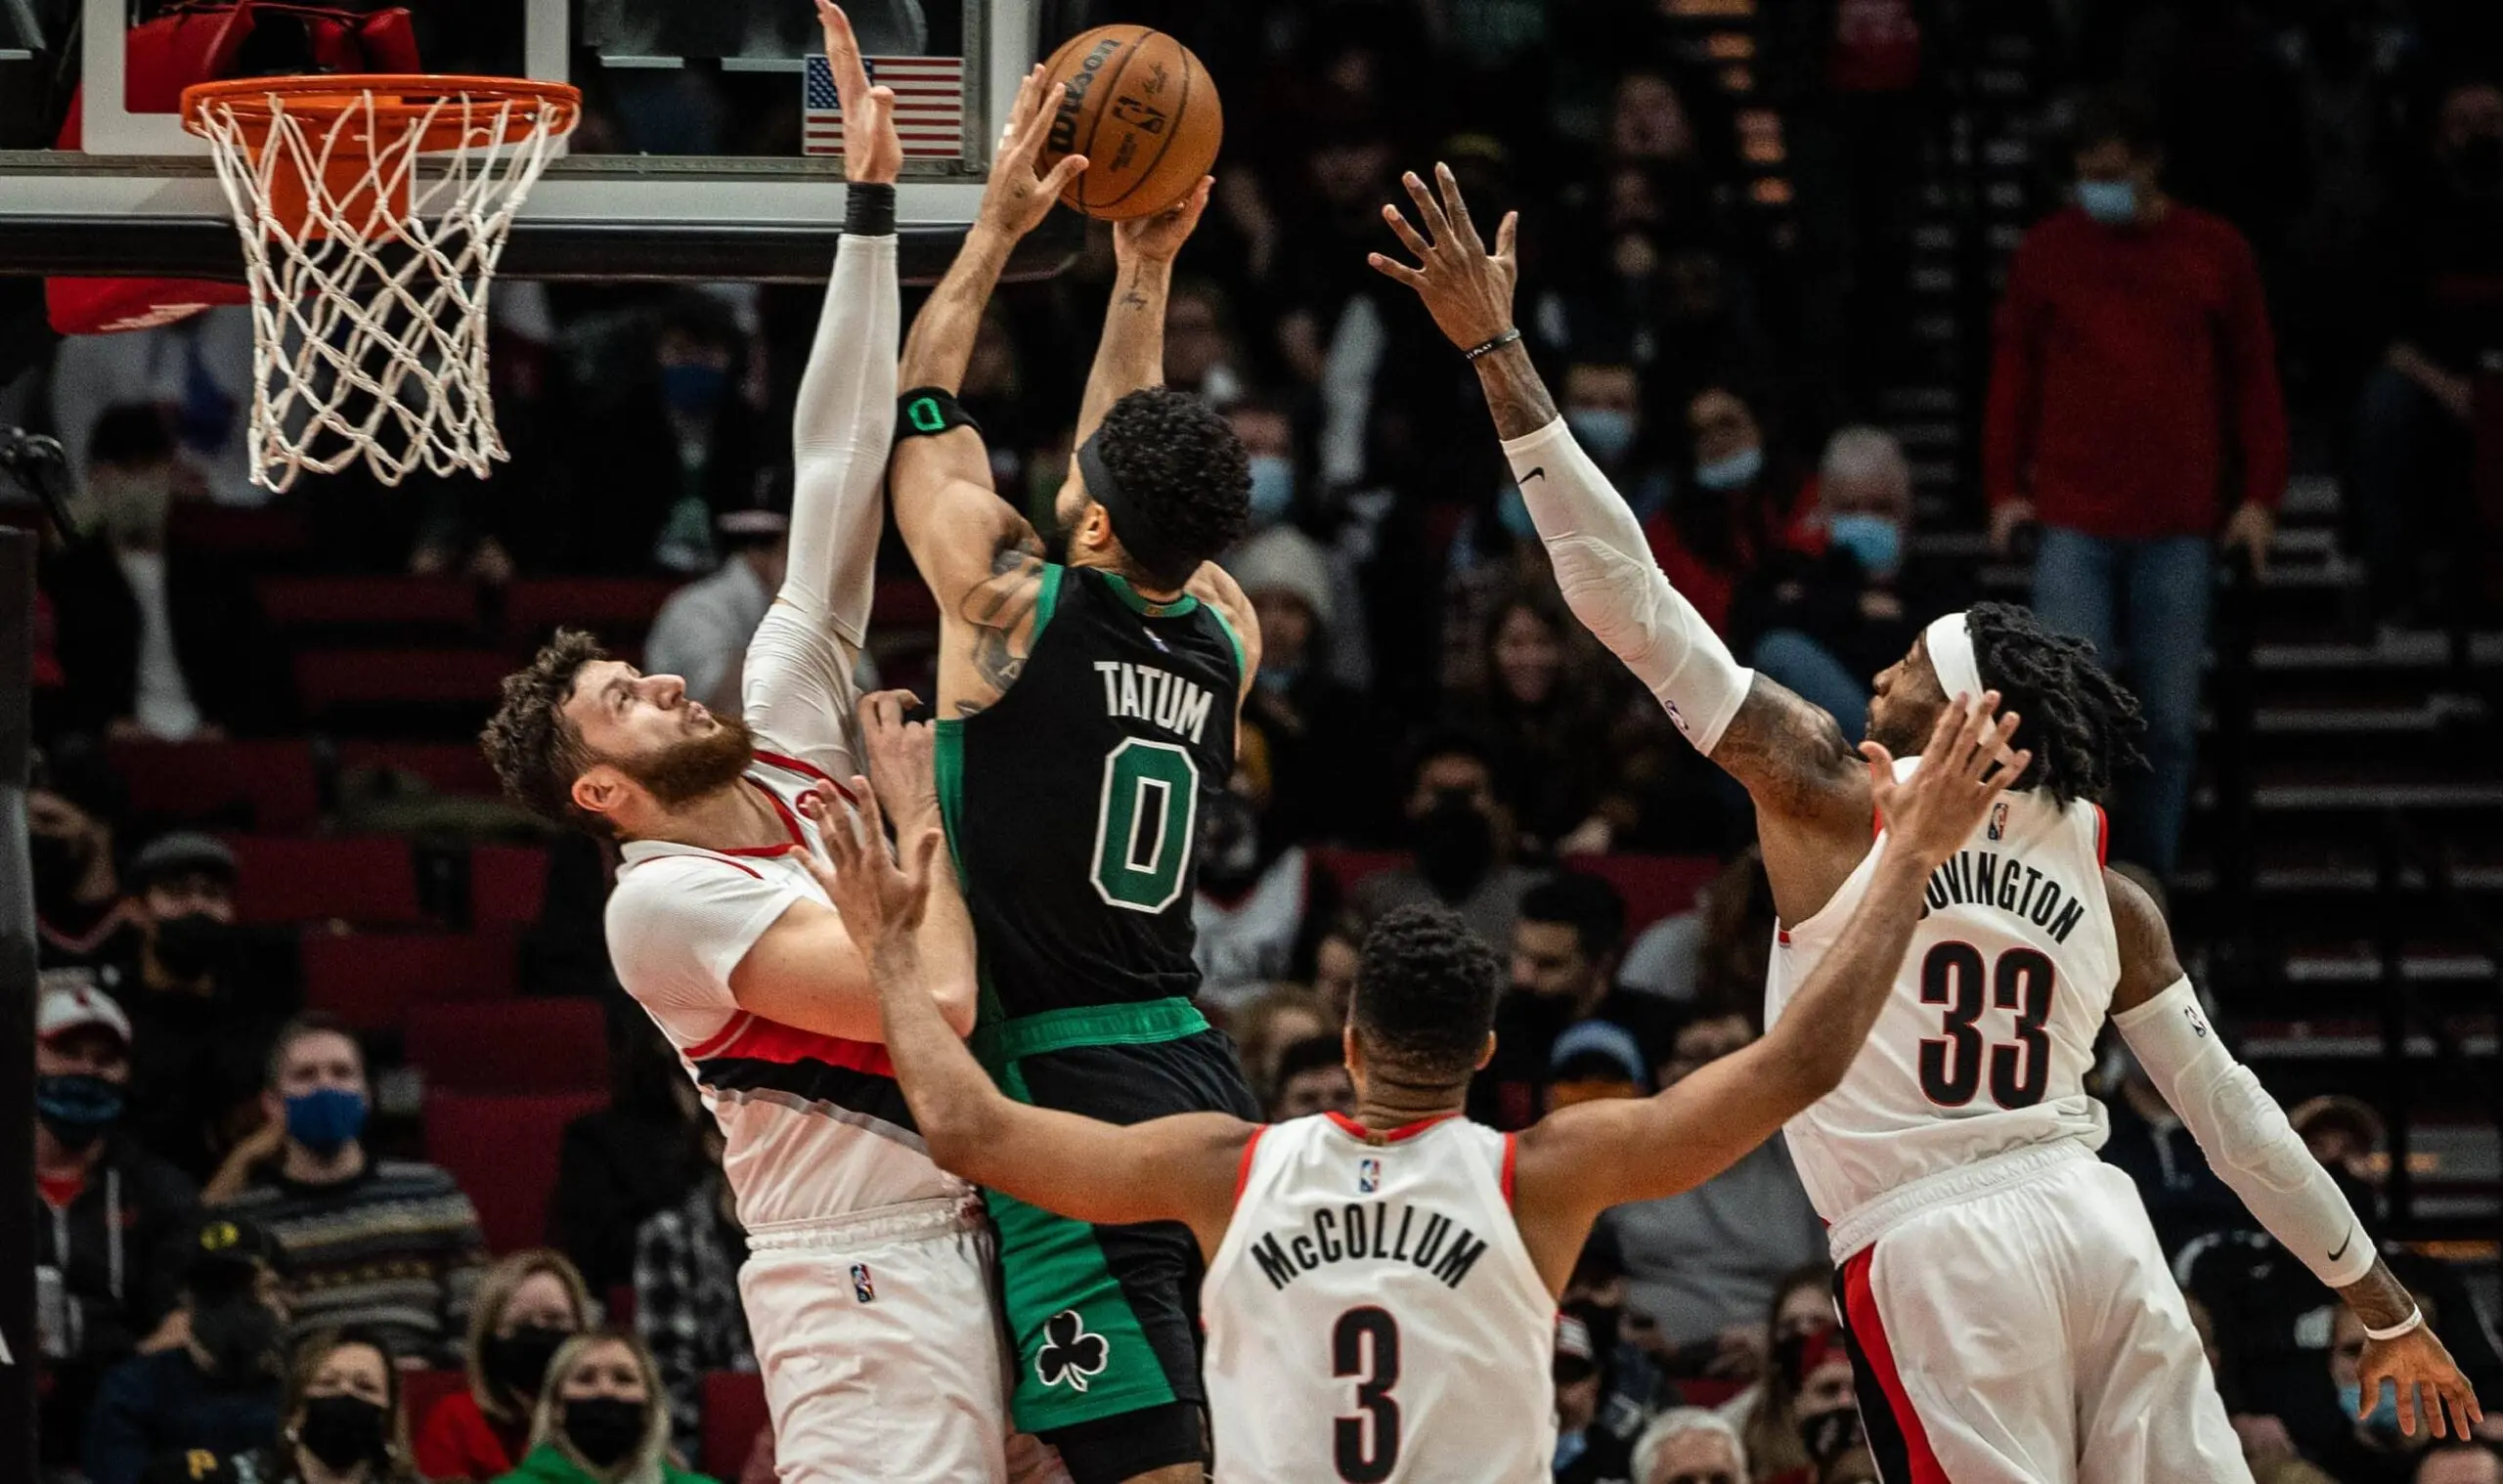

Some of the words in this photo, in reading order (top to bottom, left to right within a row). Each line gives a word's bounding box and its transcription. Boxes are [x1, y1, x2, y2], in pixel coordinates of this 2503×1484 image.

[1093, 661, 1214, 745] TATUM
[1089, 736, 1199, 914] 0
[1917, 850, 2085, 945] OVINGTON
[1918, 939, 2055, 1111] 33
[1251, 1201, 1488, 1291] McCOLLUM
[1333, 1304, 1400, 1484] 3
